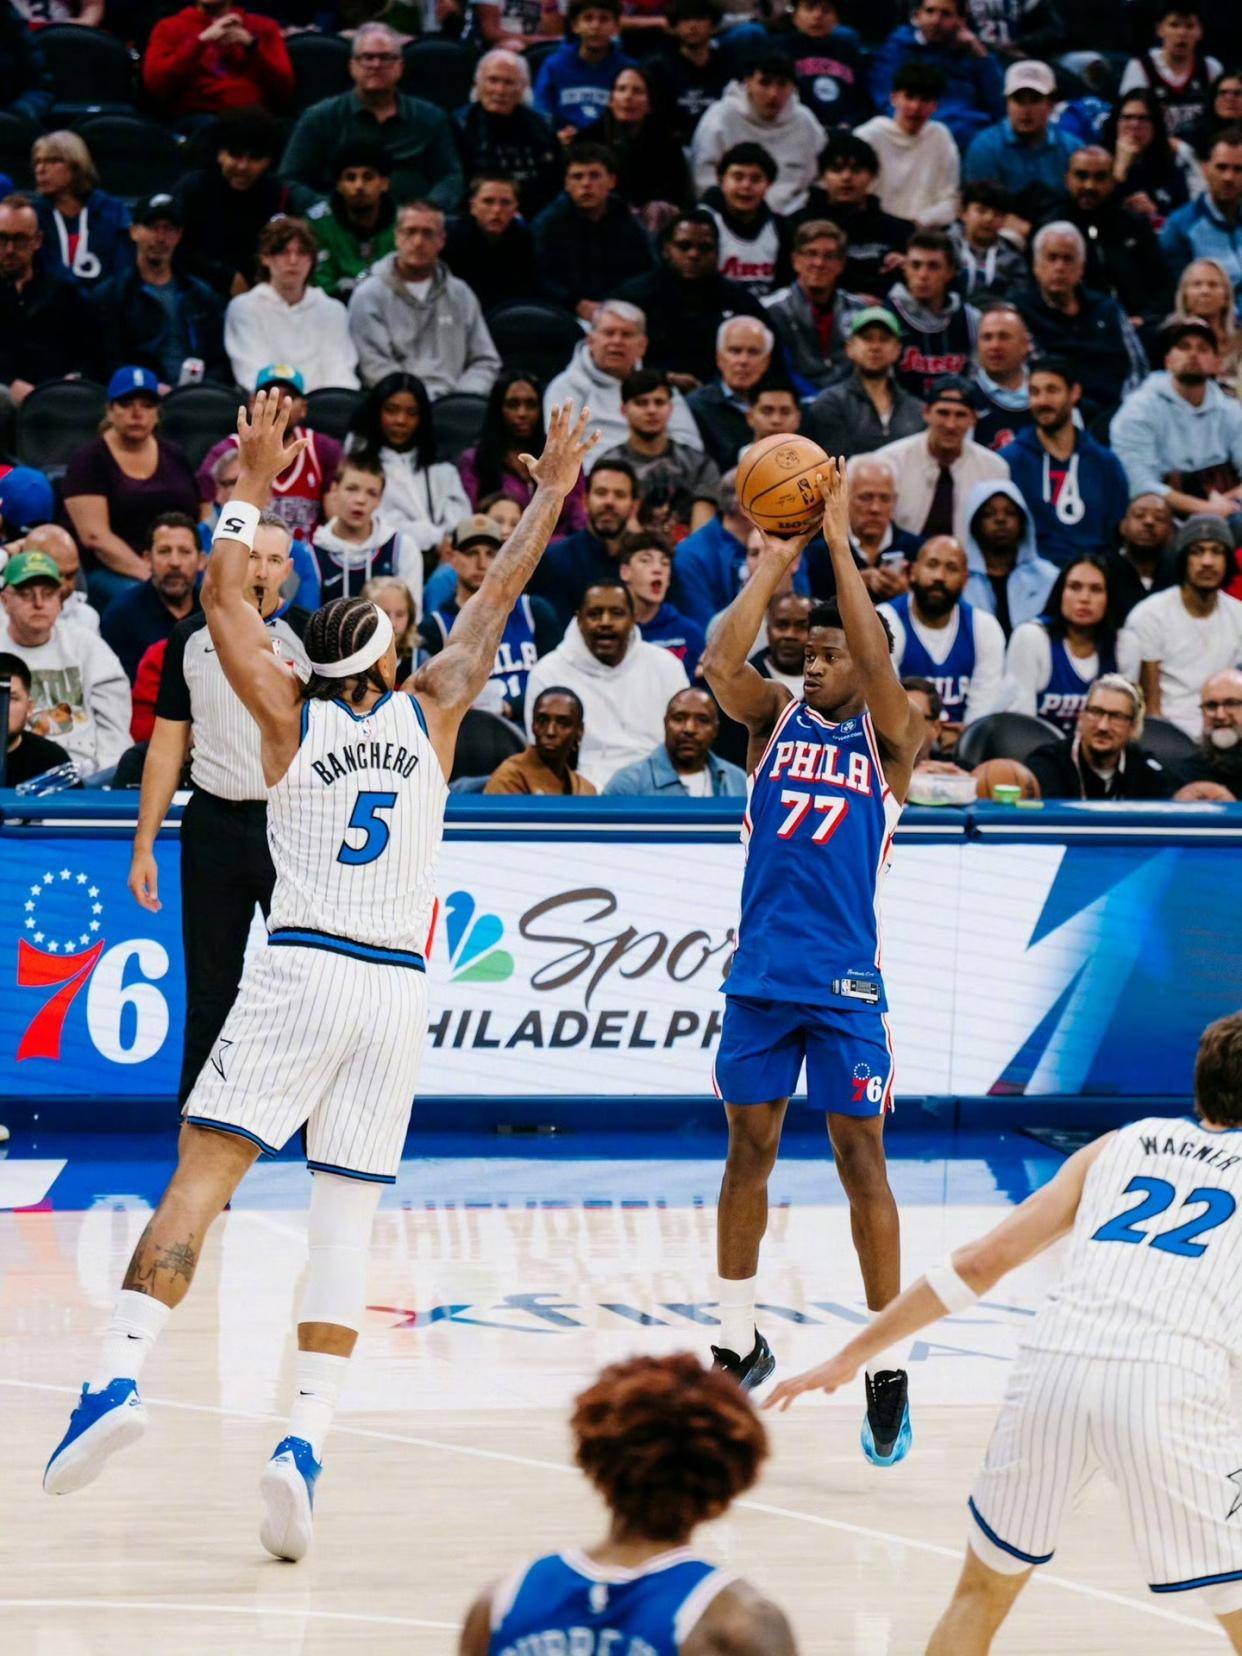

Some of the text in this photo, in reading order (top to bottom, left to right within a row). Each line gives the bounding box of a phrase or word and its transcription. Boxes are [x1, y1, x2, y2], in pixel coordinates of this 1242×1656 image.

[311, 742, 420, 786] BANCHERO
[769, 740, 873, 797] PHILA
[336, 790, 399, 866] 5
[776, 789, 849, 845] 77
[16, 937, 170, 1064] 76
[852, 1075, 883, 1103] 76
[1139, 1135, 1242, 1172] WAGNER
[1090, 1175, 1237, 1258] 22
